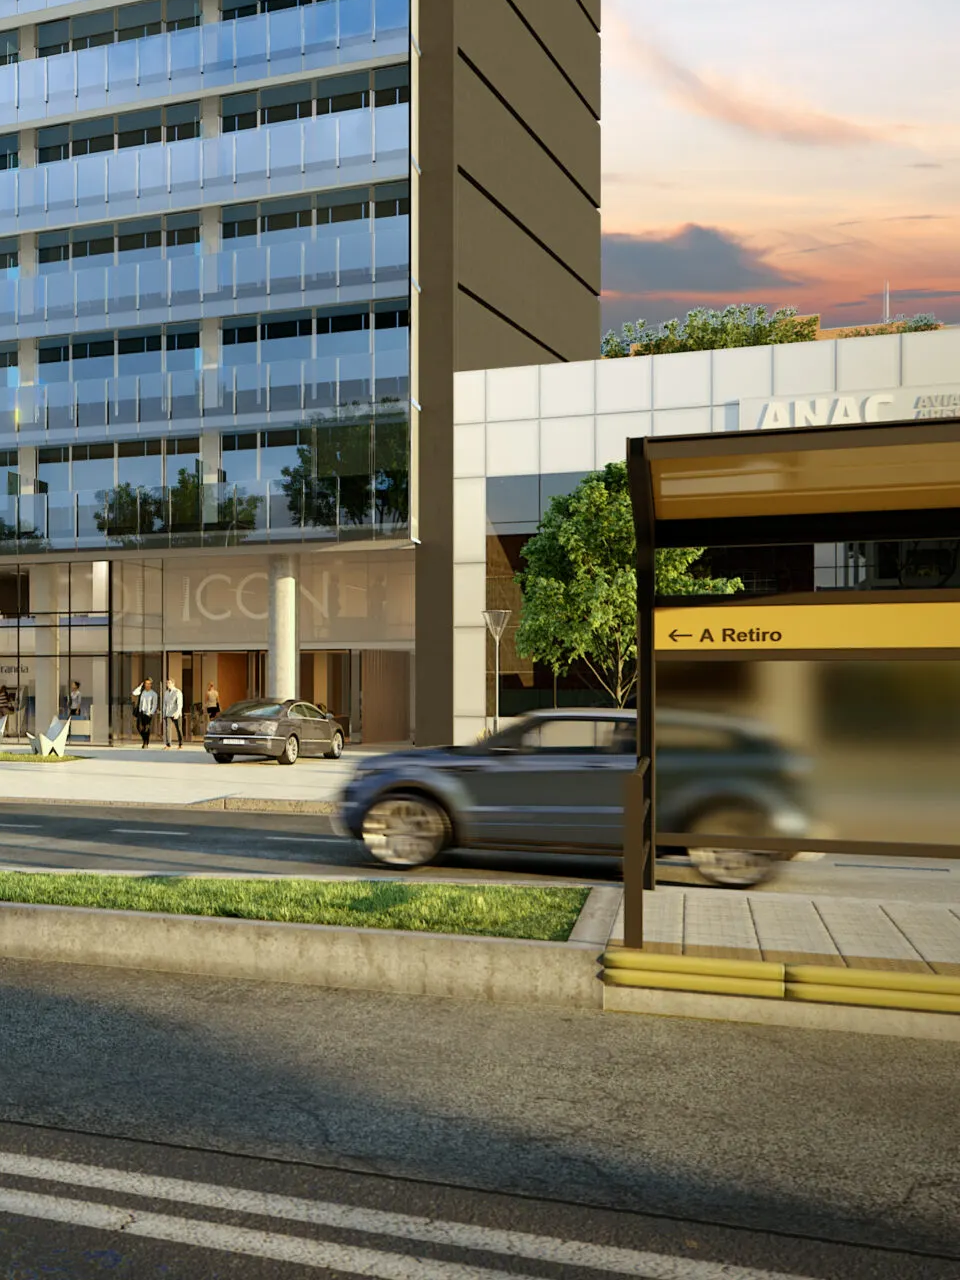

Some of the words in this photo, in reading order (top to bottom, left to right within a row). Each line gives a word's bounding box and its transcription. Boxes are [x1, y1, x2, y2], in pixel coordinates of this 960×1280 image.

[758, 394, 894, 430] ANAC
[699, 628, 714, 642] A
[722, 628, 782, 642] Retiro
